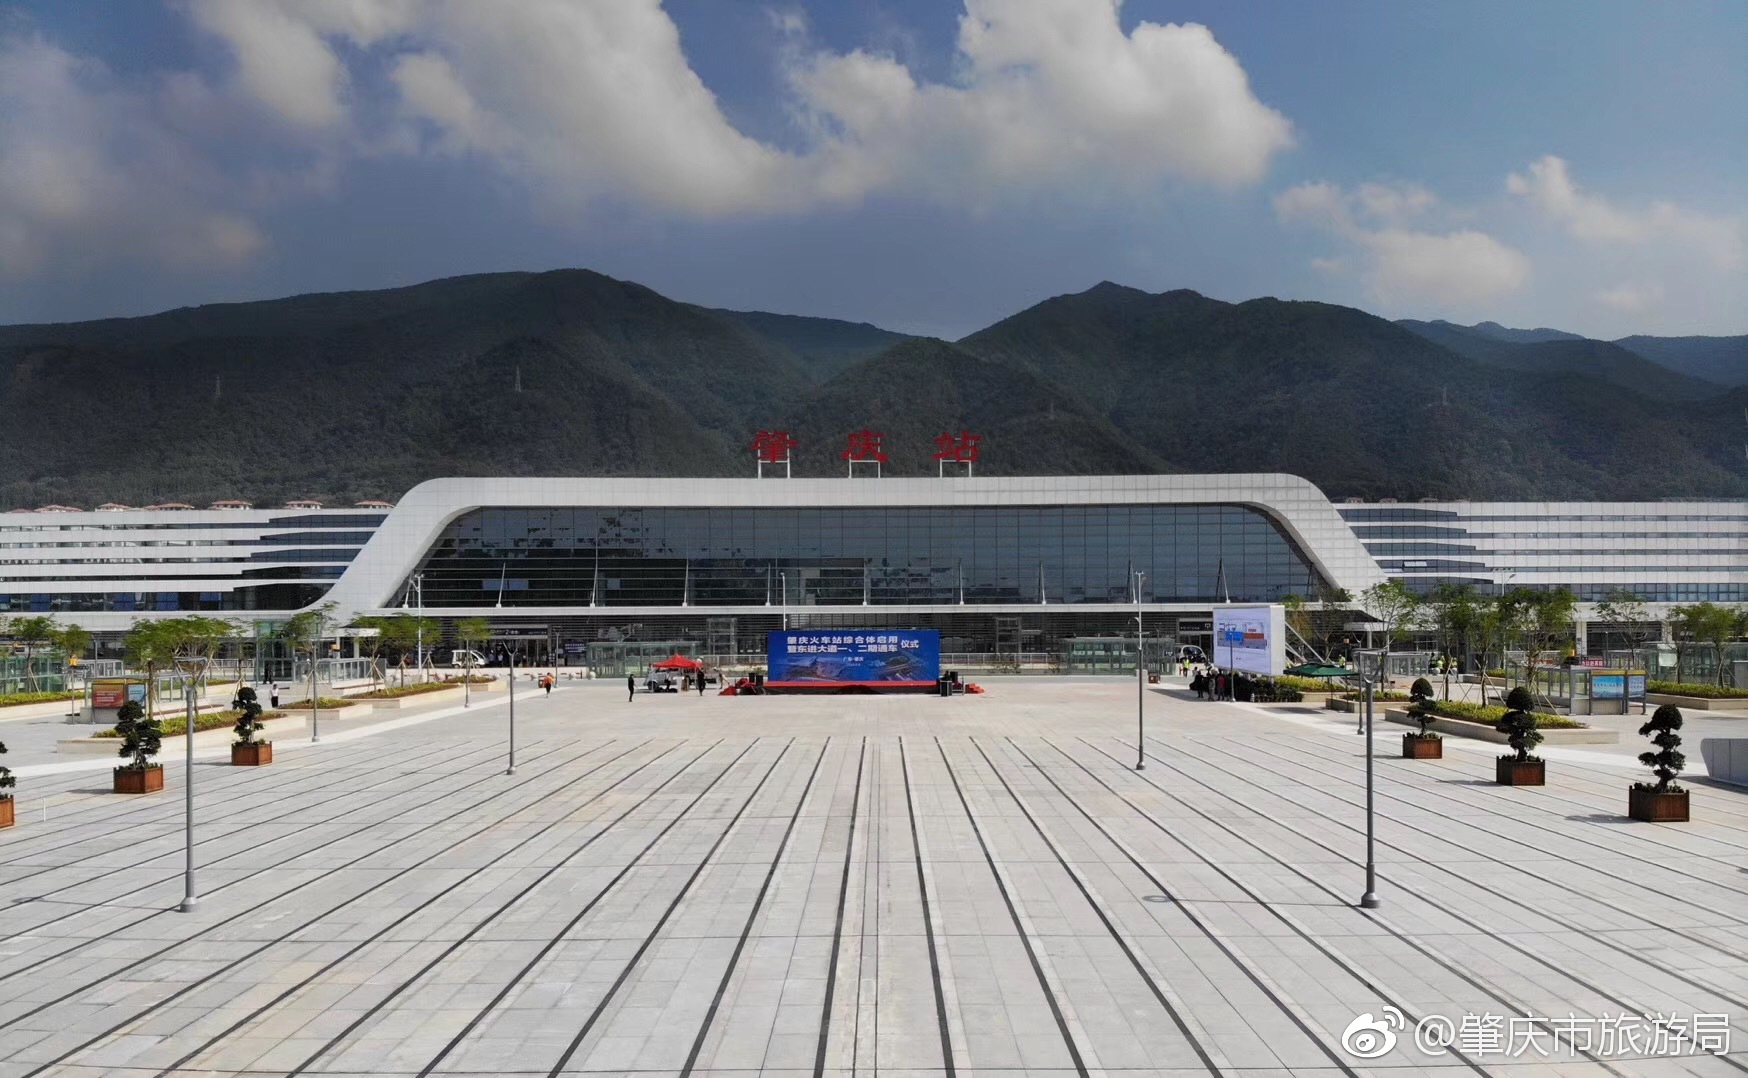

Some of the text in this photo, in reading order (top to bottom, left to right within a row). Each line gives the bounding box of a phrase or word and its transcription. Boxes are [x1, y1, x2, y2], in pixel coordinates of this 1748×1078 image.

[750, 429, 982, 463] 肇庆站
[787, 636, 898, 645] 肇庆火车站综合体启用
[901, 639, 919, 649] 仪式
